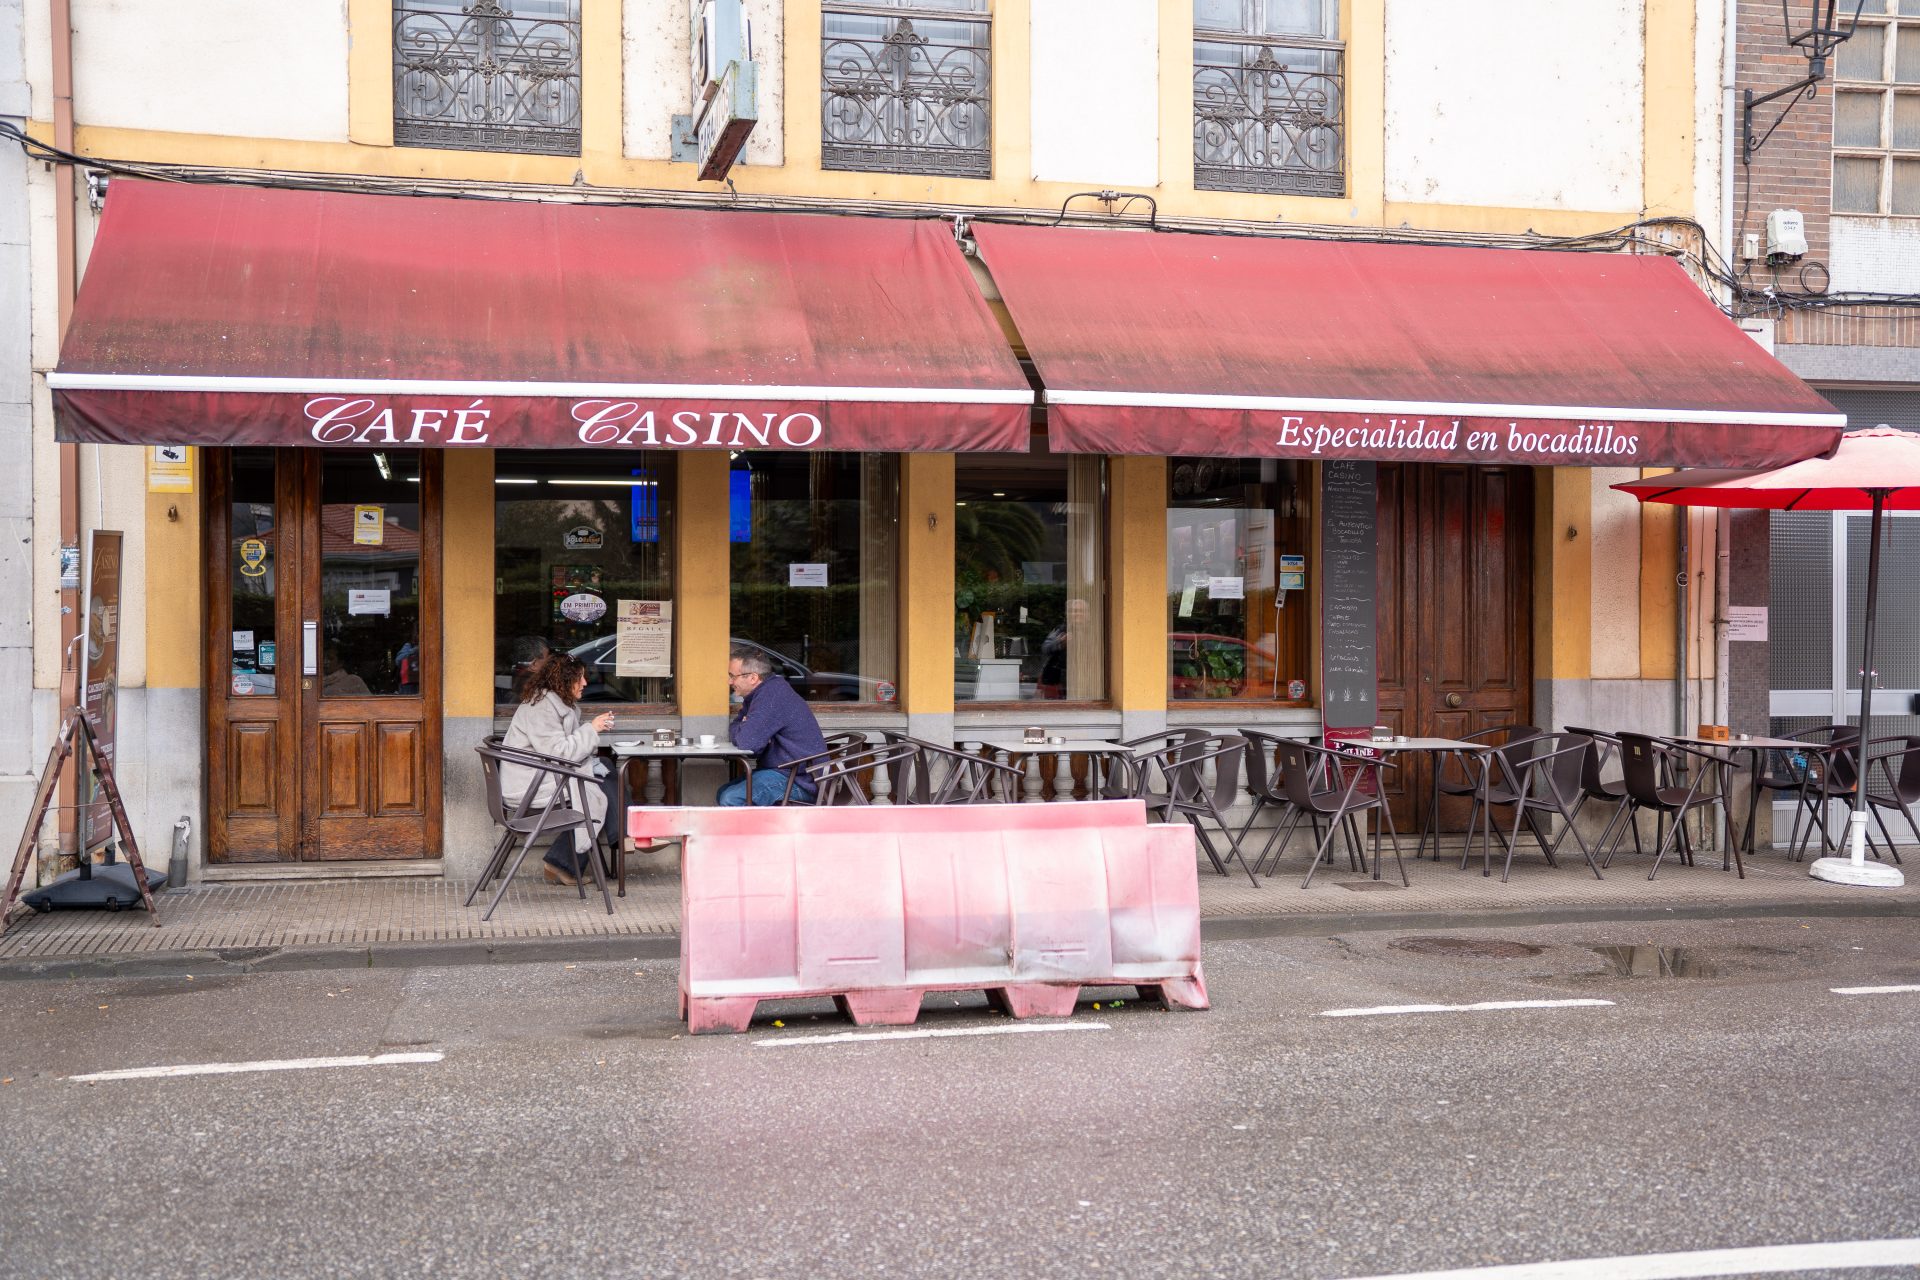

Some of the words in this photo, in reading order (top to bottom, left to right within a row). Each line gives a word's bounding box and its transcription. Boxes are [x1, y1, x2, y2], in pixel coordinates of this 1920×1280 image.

[304, 397, 491, 443] CAFÉ
[571, 399, 822, 447] CASINO
[1276, 416, 1460, 454] Especialidad
[1466, 431, 1499, 452] en
[1507, 423, 1639, 455] bocadillos
[1328, 470, 1361, 480] CASINO
